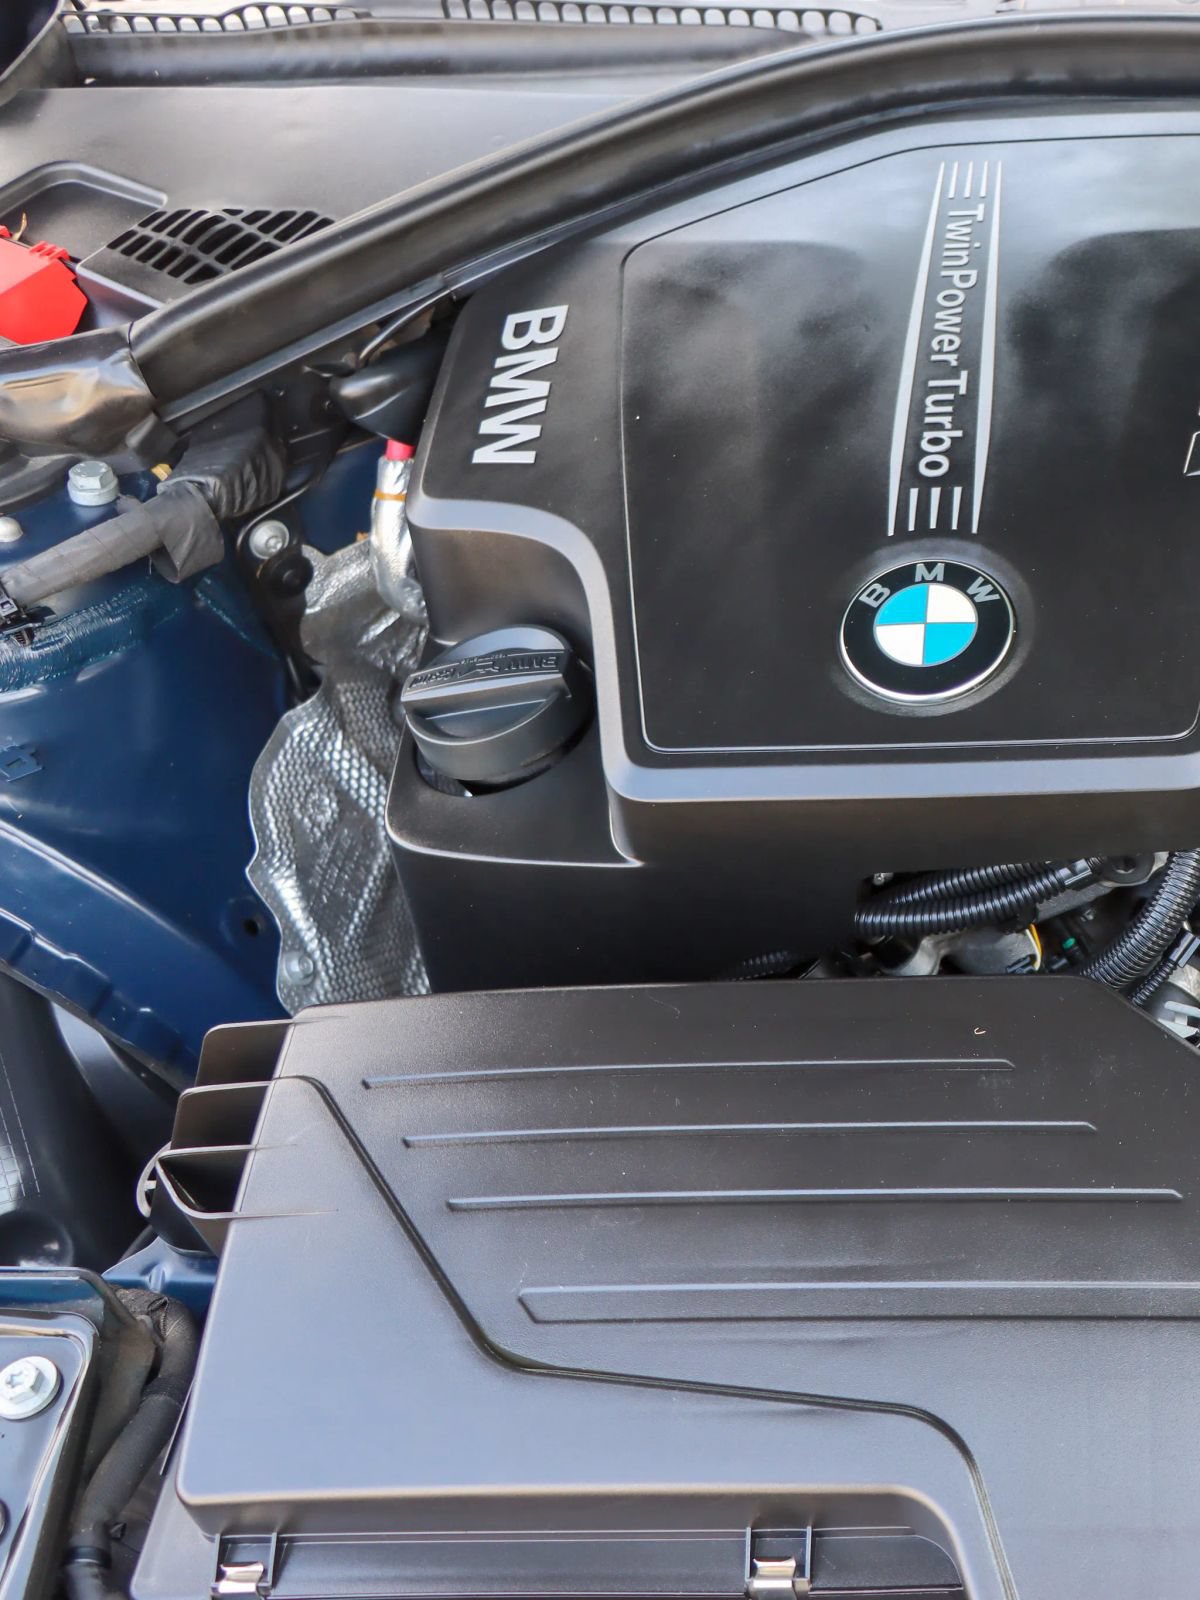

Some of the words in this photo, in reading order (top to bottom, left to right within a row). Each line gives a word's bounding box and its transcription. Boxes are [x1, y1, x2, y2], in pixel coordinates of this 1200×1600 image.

[930, 203, 984, 367] TwinPower
[472, 304, 569, 463] BMW
[918, 370, 968, 477] Turbo
[858, 562, 1000, 609] BMW
